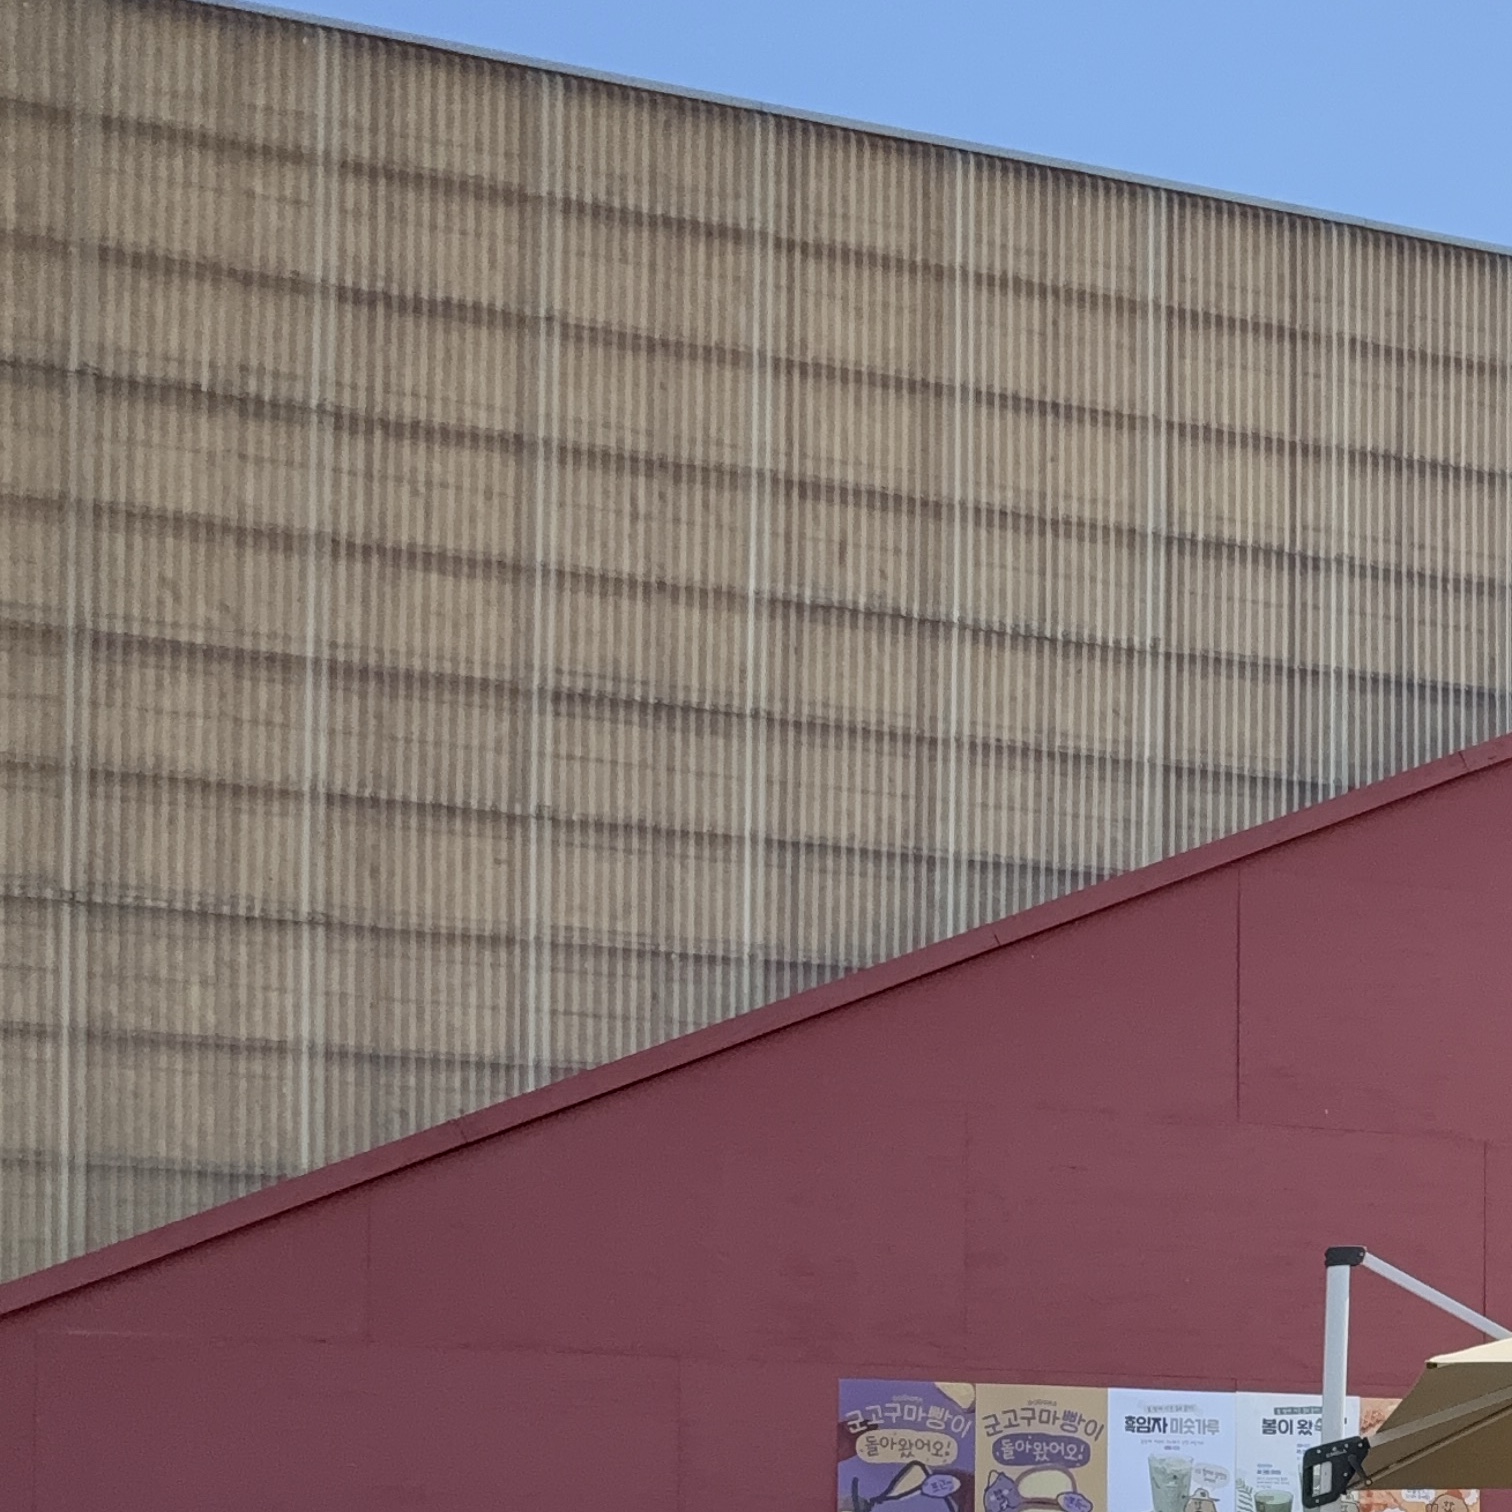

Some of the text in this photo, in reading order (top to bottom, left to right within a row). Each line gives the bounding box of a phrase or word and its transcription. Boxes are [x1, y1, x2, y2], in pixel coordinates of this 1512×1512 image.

[846, 1402, 972, 1438] 군고구마빵이
[982, 1407, 1104, 1441] 군고구마빵이
[1125, 1416, 1220, 1436] 흑임자 미숫가루
[1262, 1418, 1293, 1435] 봄이
